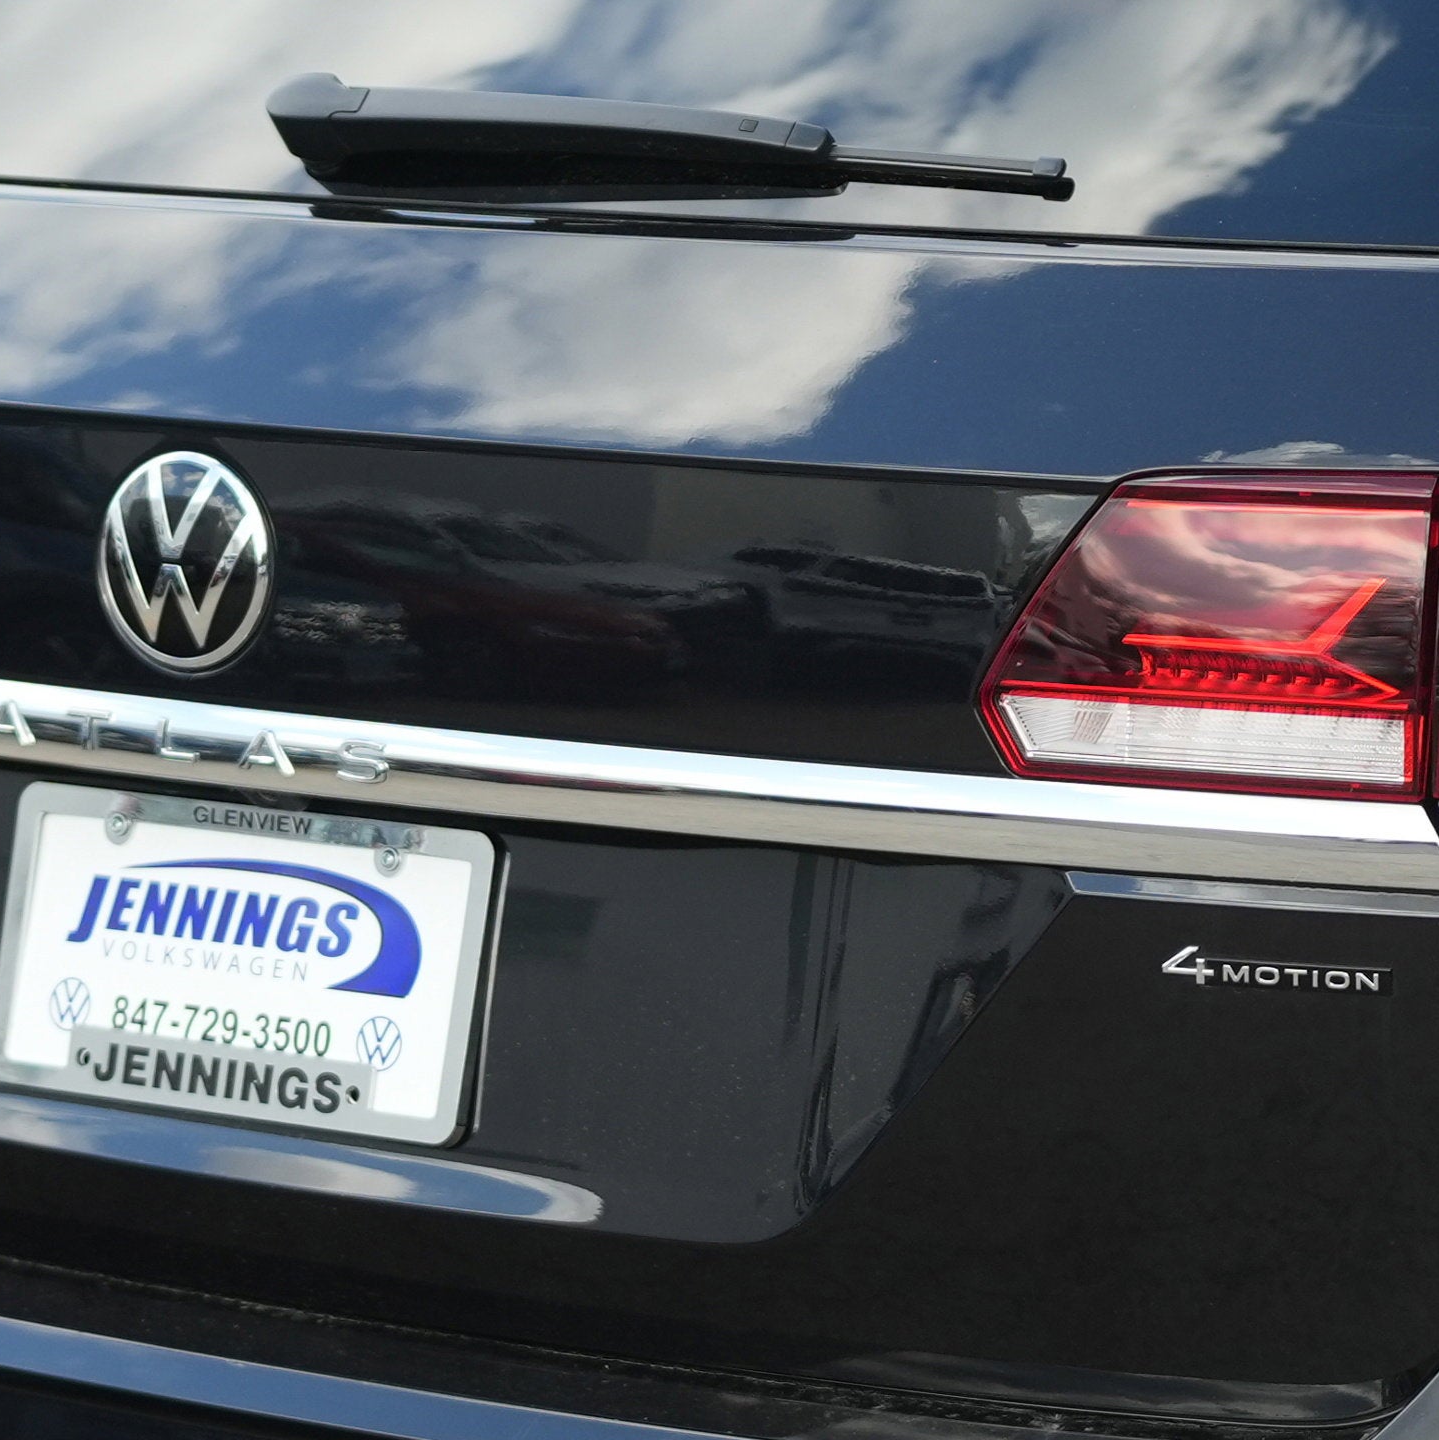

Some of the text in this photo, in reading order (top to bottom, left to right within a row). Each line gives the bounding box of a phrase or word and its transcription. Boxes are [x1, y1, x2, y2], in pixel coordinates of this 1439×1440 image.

[193, 805, 312, 835] GLENVIEW
[66, 874, 360, 959] JENNINGS
[102, 938, 309, 982] VOLKSWAGEN
[1161, 945, 1379, 992] 4MOTION
[112, 995, 332, 1057] 847-729-3500
[93, 1043, 343, 1114] JENNINGS
